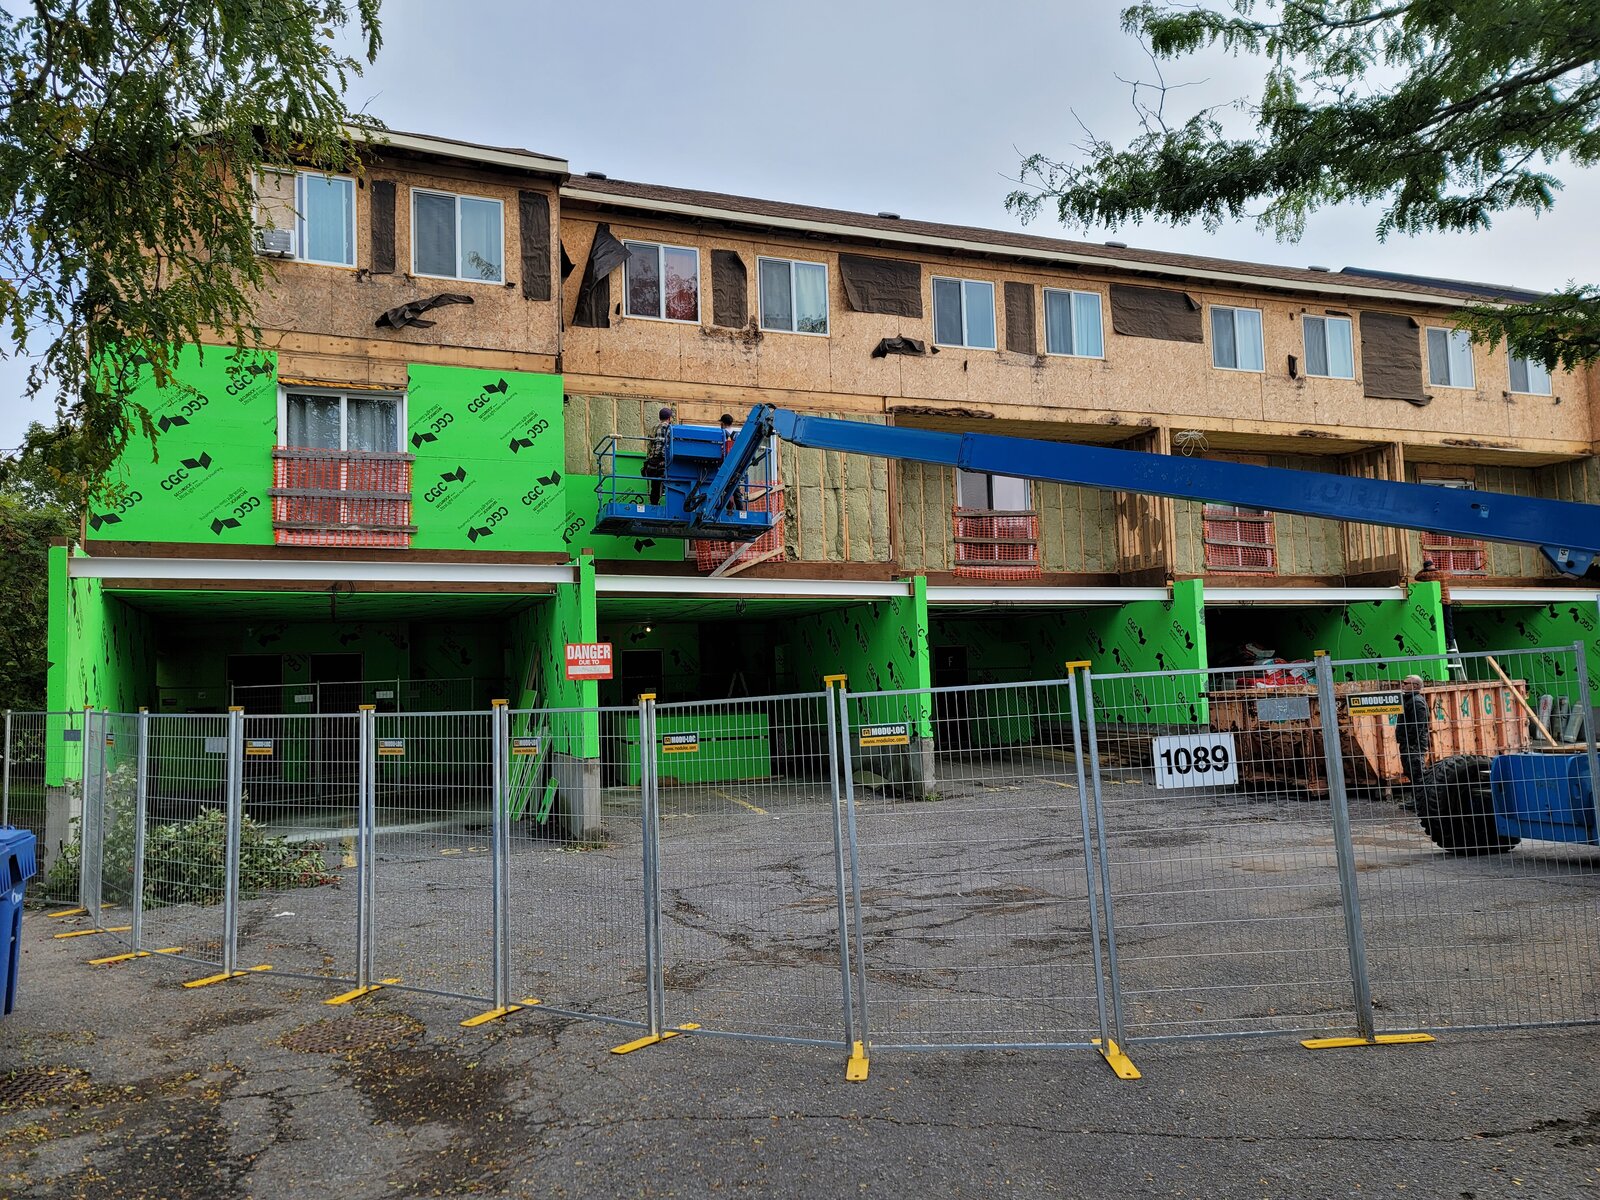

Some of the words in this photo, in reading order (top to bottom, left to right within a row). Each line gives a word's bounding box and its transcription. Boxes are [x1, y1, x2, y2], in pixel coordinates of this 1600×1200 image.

[226, 374, 252, 396] CGC
[181, 395, 208, 416] CGC
[467, 393, 490, 413] CGC
[430, 413, 454, 434] CGC
[526, 419, 549, 439] CGC
[160, 468, 189, 490] CGC
[118, 491, 143, 514] CGC
[424, 482, 448, 503] CGC
[522, 486, 544, 506] CGC
[234, 496, 260, 518] CGC
[486, 506, 509, 527] CGC
[565, 518, 586, 536] CGC
[1415, 604, 1429, 620] CGC
[1128, 617, 1138, 634] CGC
[1172, 620, 1185, 636] CGC
[1350, 620, 1362, 636] CGC
[1580, 618, 1594, 632] CGC
[1525, 631, 1538, 645] CGC
[567, 645, 610, 660] DANGER
[1364, 644, 1376, 658] CGC
[1160, 745, 1228, 775] 1089
